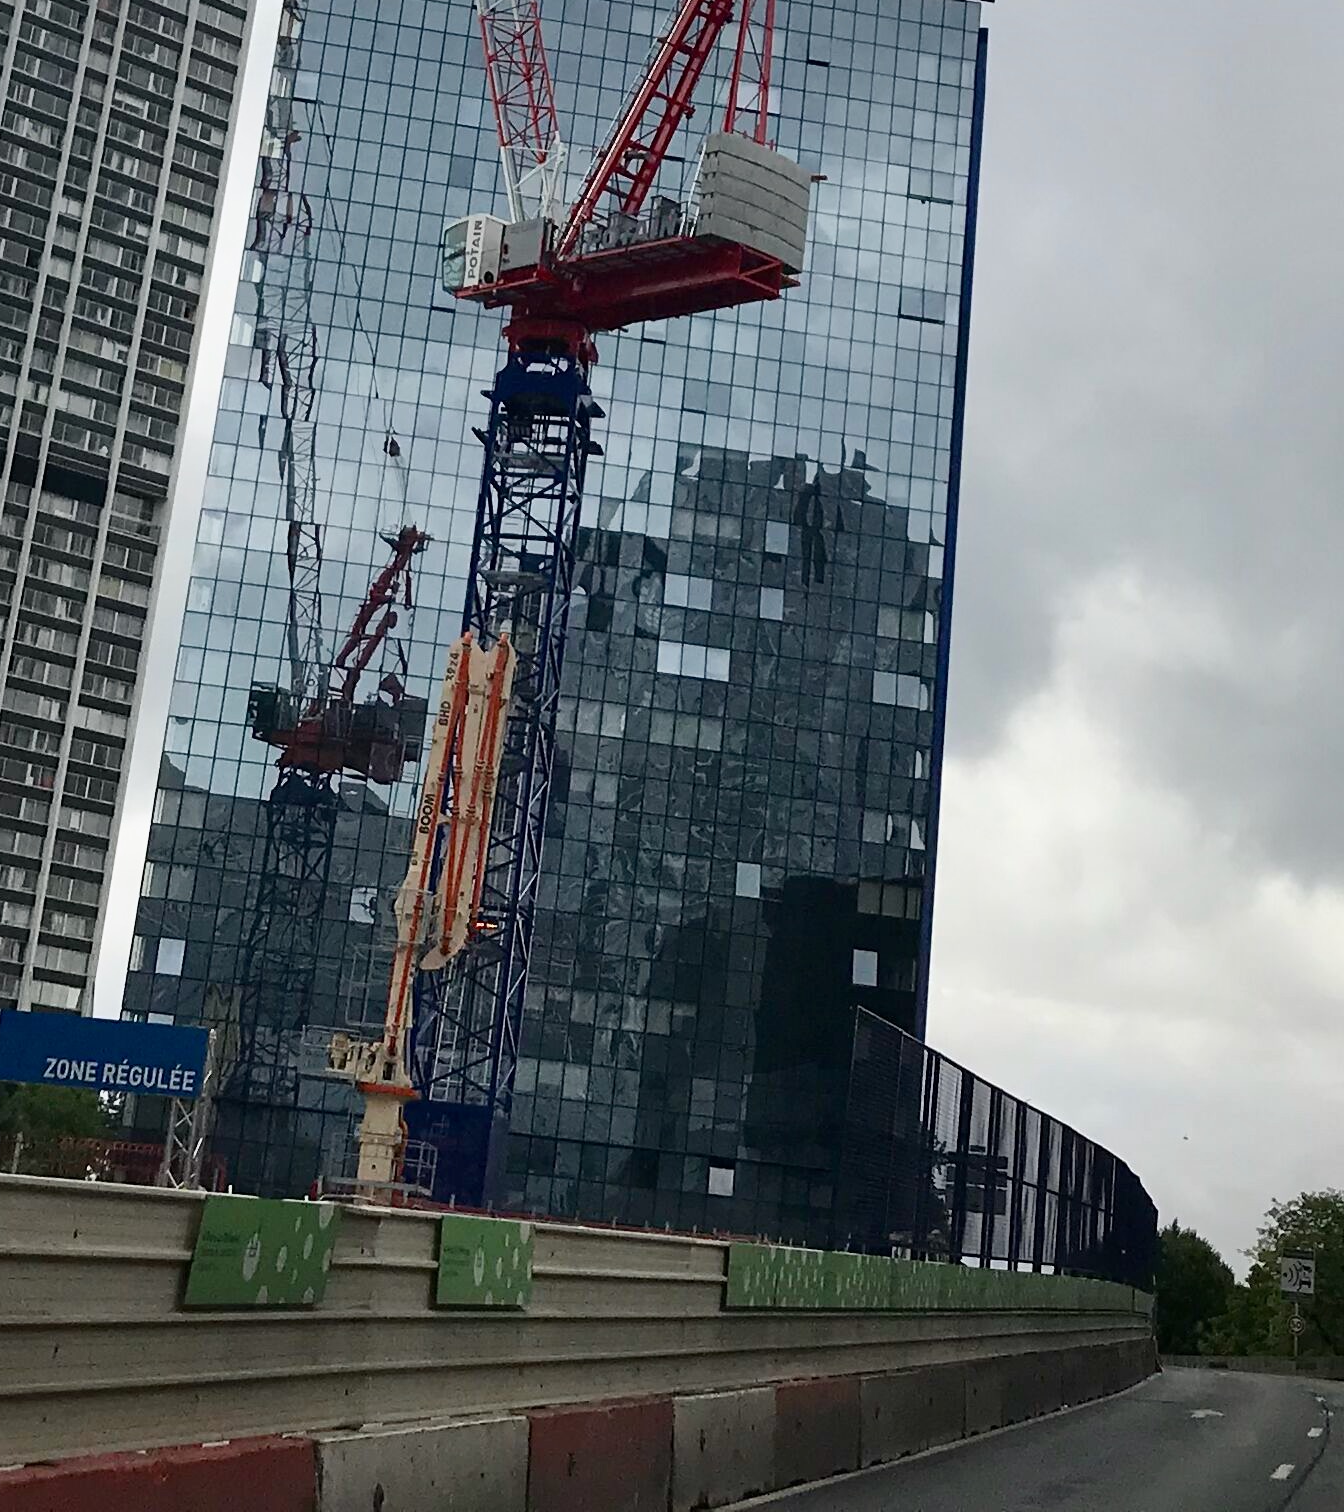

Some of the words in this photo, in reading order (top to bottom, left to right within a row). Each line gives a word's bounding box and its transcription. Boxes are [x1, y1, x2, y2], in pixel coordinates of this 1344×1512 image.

[468, 220, 483, 279] POTAIN
[419, 793, 435, 834] BOOM
[438, 700, 451, 726] BHD
[43, 1057, 98, 1082] ZONE
[102, 1059, 196, 1092] RÉGULÉE
